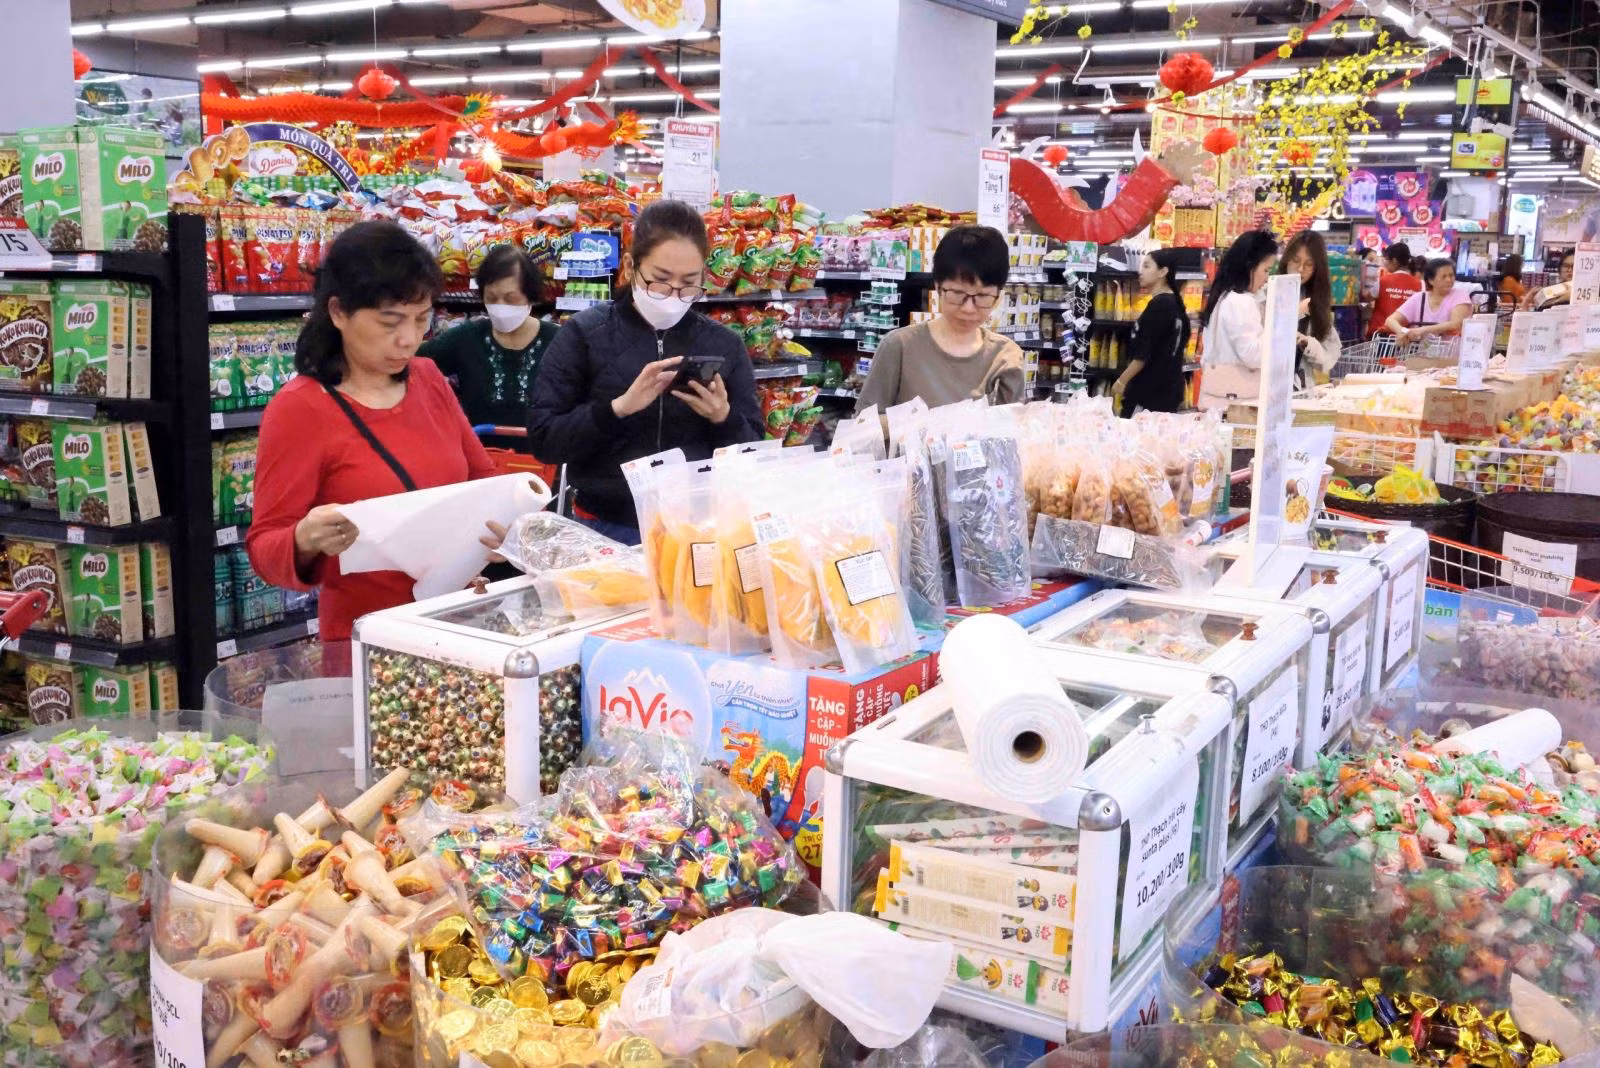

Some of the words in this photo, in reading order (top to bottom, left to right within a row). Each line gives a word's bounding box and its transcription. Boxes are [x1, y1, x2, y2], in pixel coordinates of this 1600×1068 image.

[280, 128, 308, 147] MÓN
[35, 161, 63, 177] MILO
[121, 164, 151, 178] MILO
[259, 155, 294, 174] Danisa
[1581, 257, 1594, 270] 129
[1577, 288, 1592, 300] 245
[68, 311, 95, 325] MILO
[65, 442, 89, 455] MILO
[83, 560, 107, 573] MILO
[95, 685, 117, 698] MILO
[809, 696, 846, 716] TẶNG
[817, 715, 835, 731] CẶP
[1151, 820, 1168, 840] Thạch
[1176, 801, 1187, 816] cây
[802, 844, 821, 860] 27
[1136, 851, 1185, 908] 10,200/100g
[166, 1000, 181, 1020] SCL
